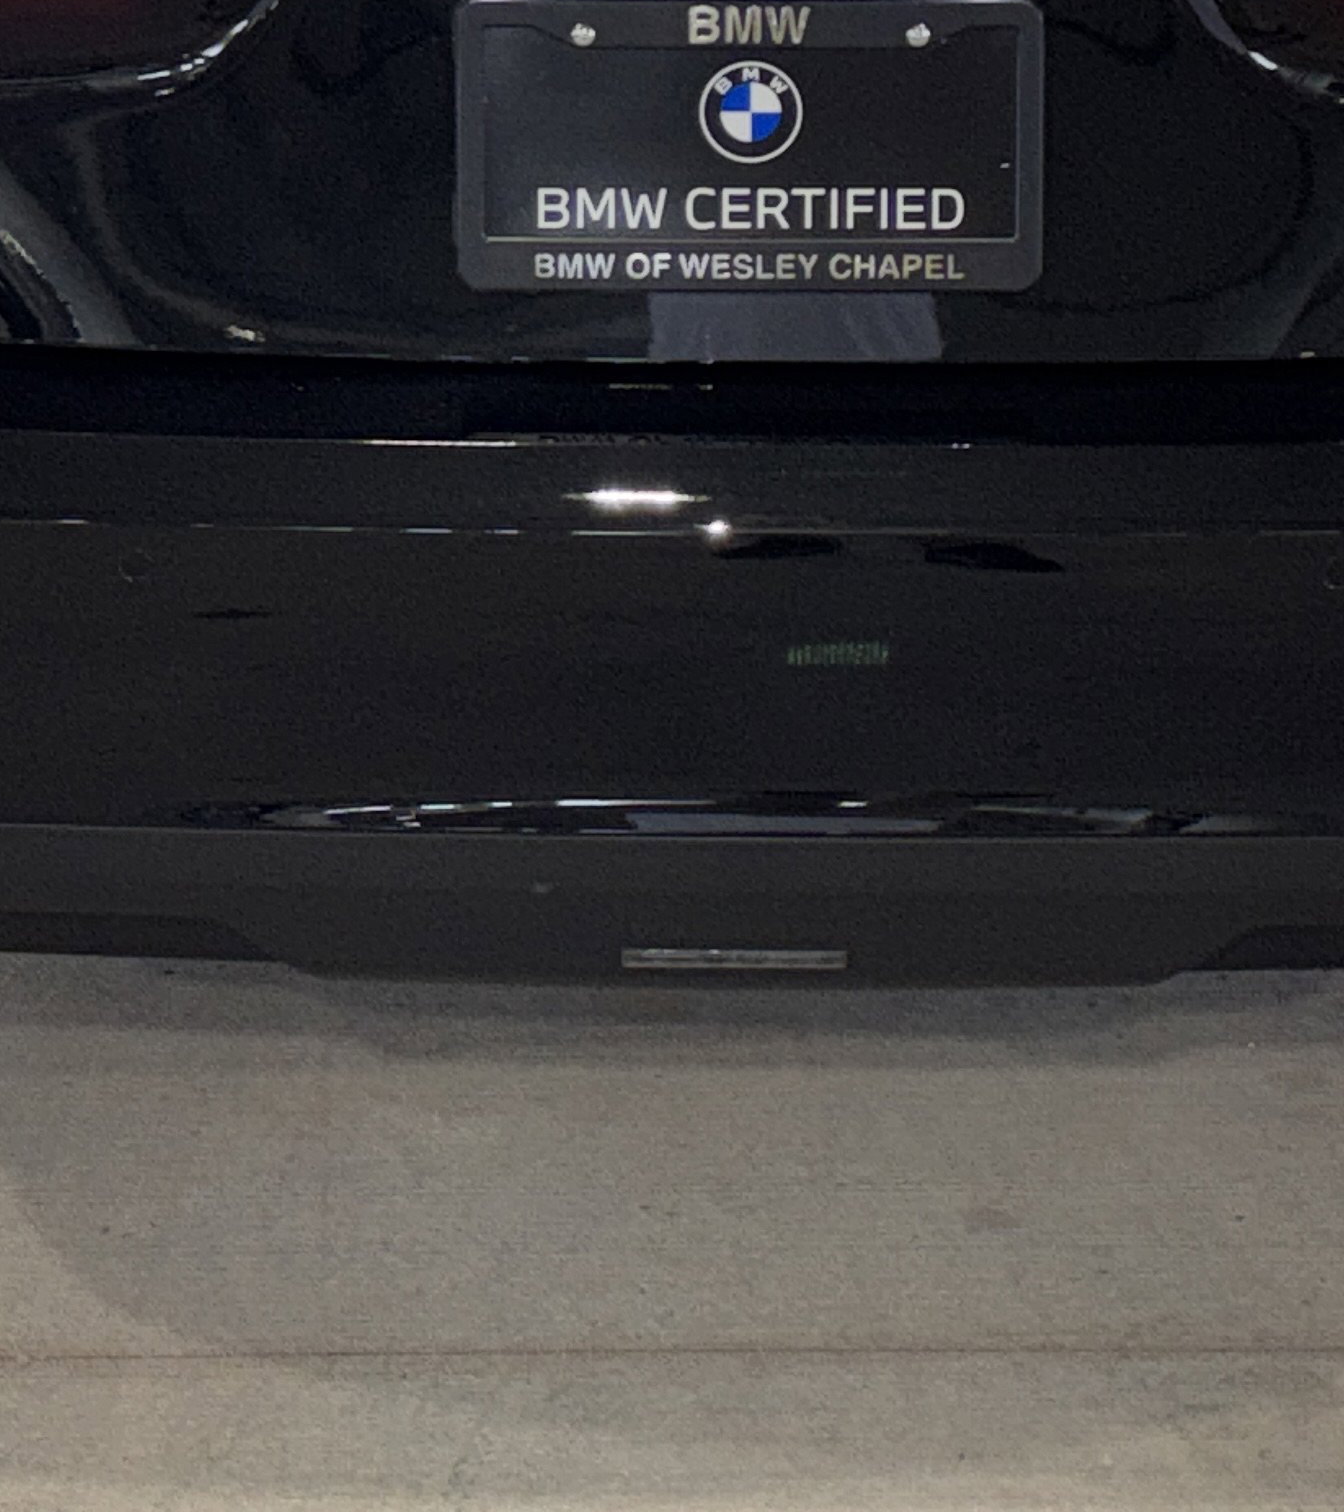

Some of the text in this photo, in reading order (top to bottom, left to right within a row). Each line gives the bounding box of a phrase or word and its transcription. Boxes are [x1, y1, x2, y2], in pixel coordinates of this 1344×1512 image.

[687, 5, 810, 45] BMW
[714, 67, 789, 95] BMW
[536, 187, 965, 231] BMW CERTIFIED
[534, 252, 964, 280] BMW OF WESLEY CHAPEL
